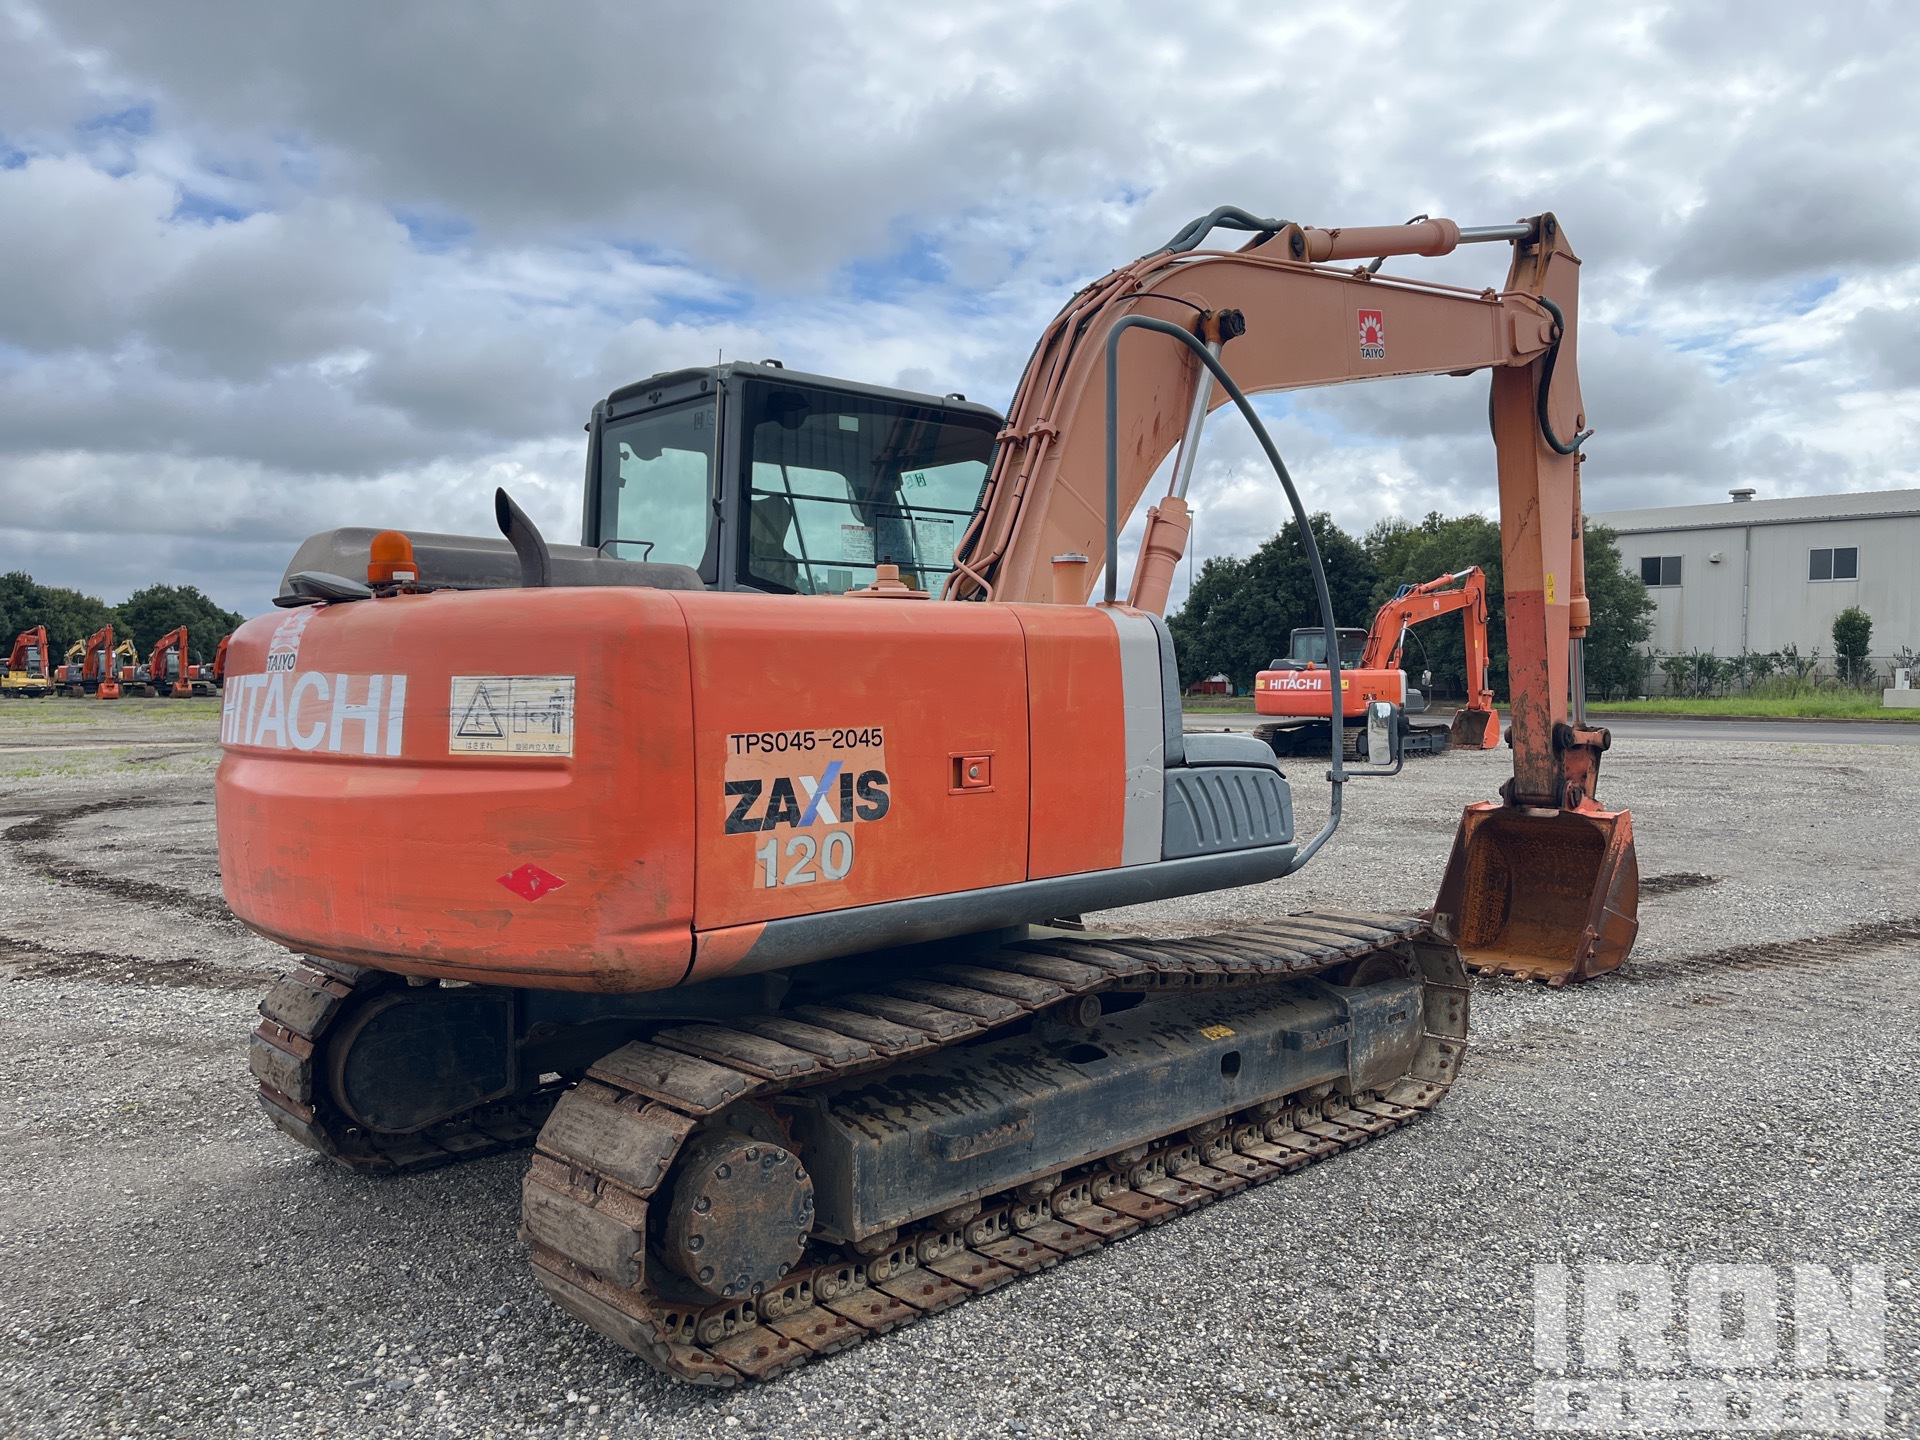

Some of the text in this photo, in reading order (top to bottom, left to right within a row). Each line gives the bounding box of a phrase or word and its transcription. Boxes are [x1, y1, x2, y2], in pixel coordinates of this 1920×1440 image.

[1361, 348, 1385, 358] TAIYO
[267, 653, 296, 672] TAIYO
[1269, 678, 1322, 690] HITACHI
[221, 671, 407, 756] HITACHI
[465, 741, 494, 750] はさまれ
[731, 728, 883, 755] TPS045-2045
[724, 760, 890, 835] ZAXIS
[756, 830, 854, 889] 120
